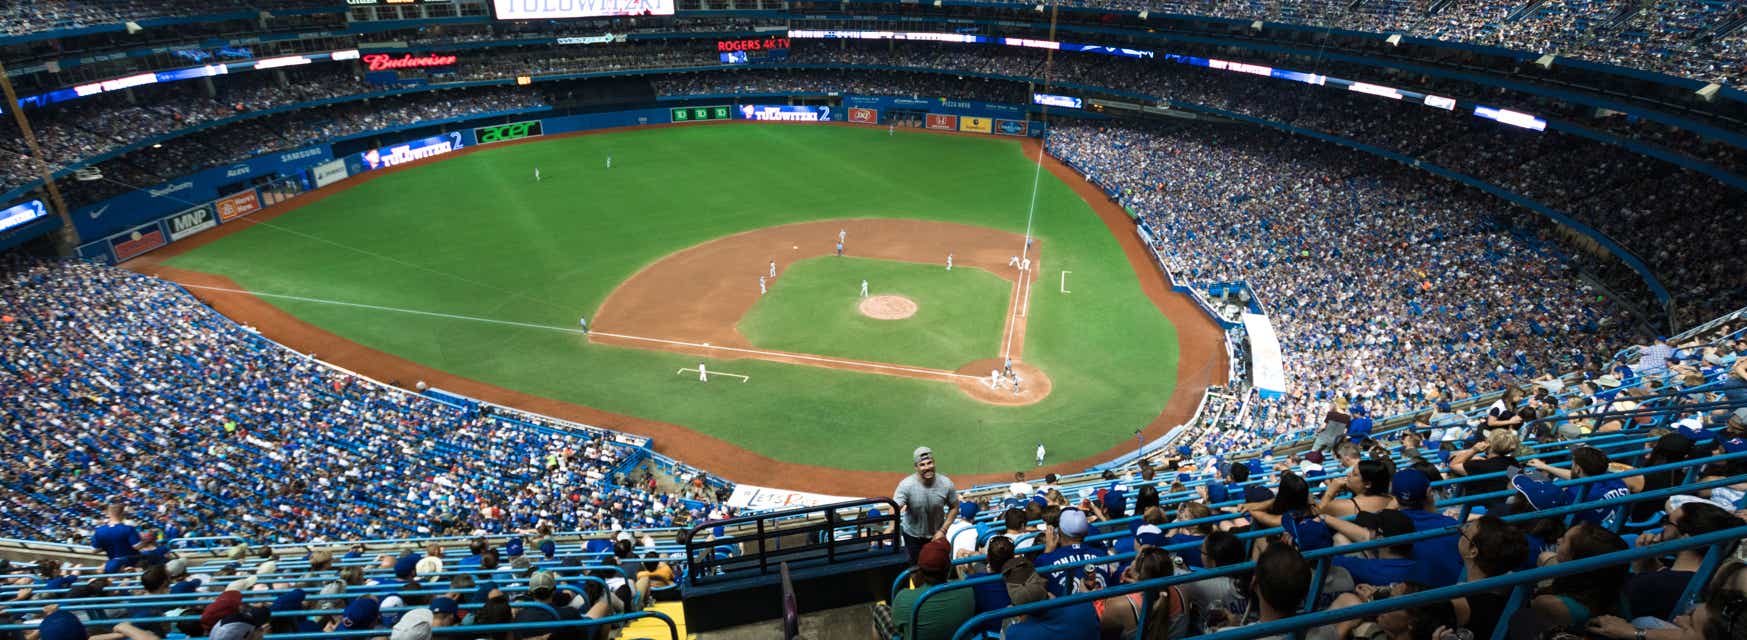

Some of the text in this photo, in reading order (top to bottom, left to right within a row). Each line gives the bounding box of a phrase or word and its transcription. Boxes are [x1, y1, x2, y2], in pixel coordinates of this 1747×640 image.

[718, 39, 791, 51] ROGERS 4K TV
[363, 53, 456, 71] Budweiser
[755, 111, 818, 121] TULOWITZKI
[819, 106, 831, 120] 2
[482, 121, 537, 143] acer
[281, 148, 322, 163] SAMSUNG
[382, 131, 465, 167] TULOWITZKI 2
[32, 200, 47, 216] 2
[173, 209, 207, 233] MNP
